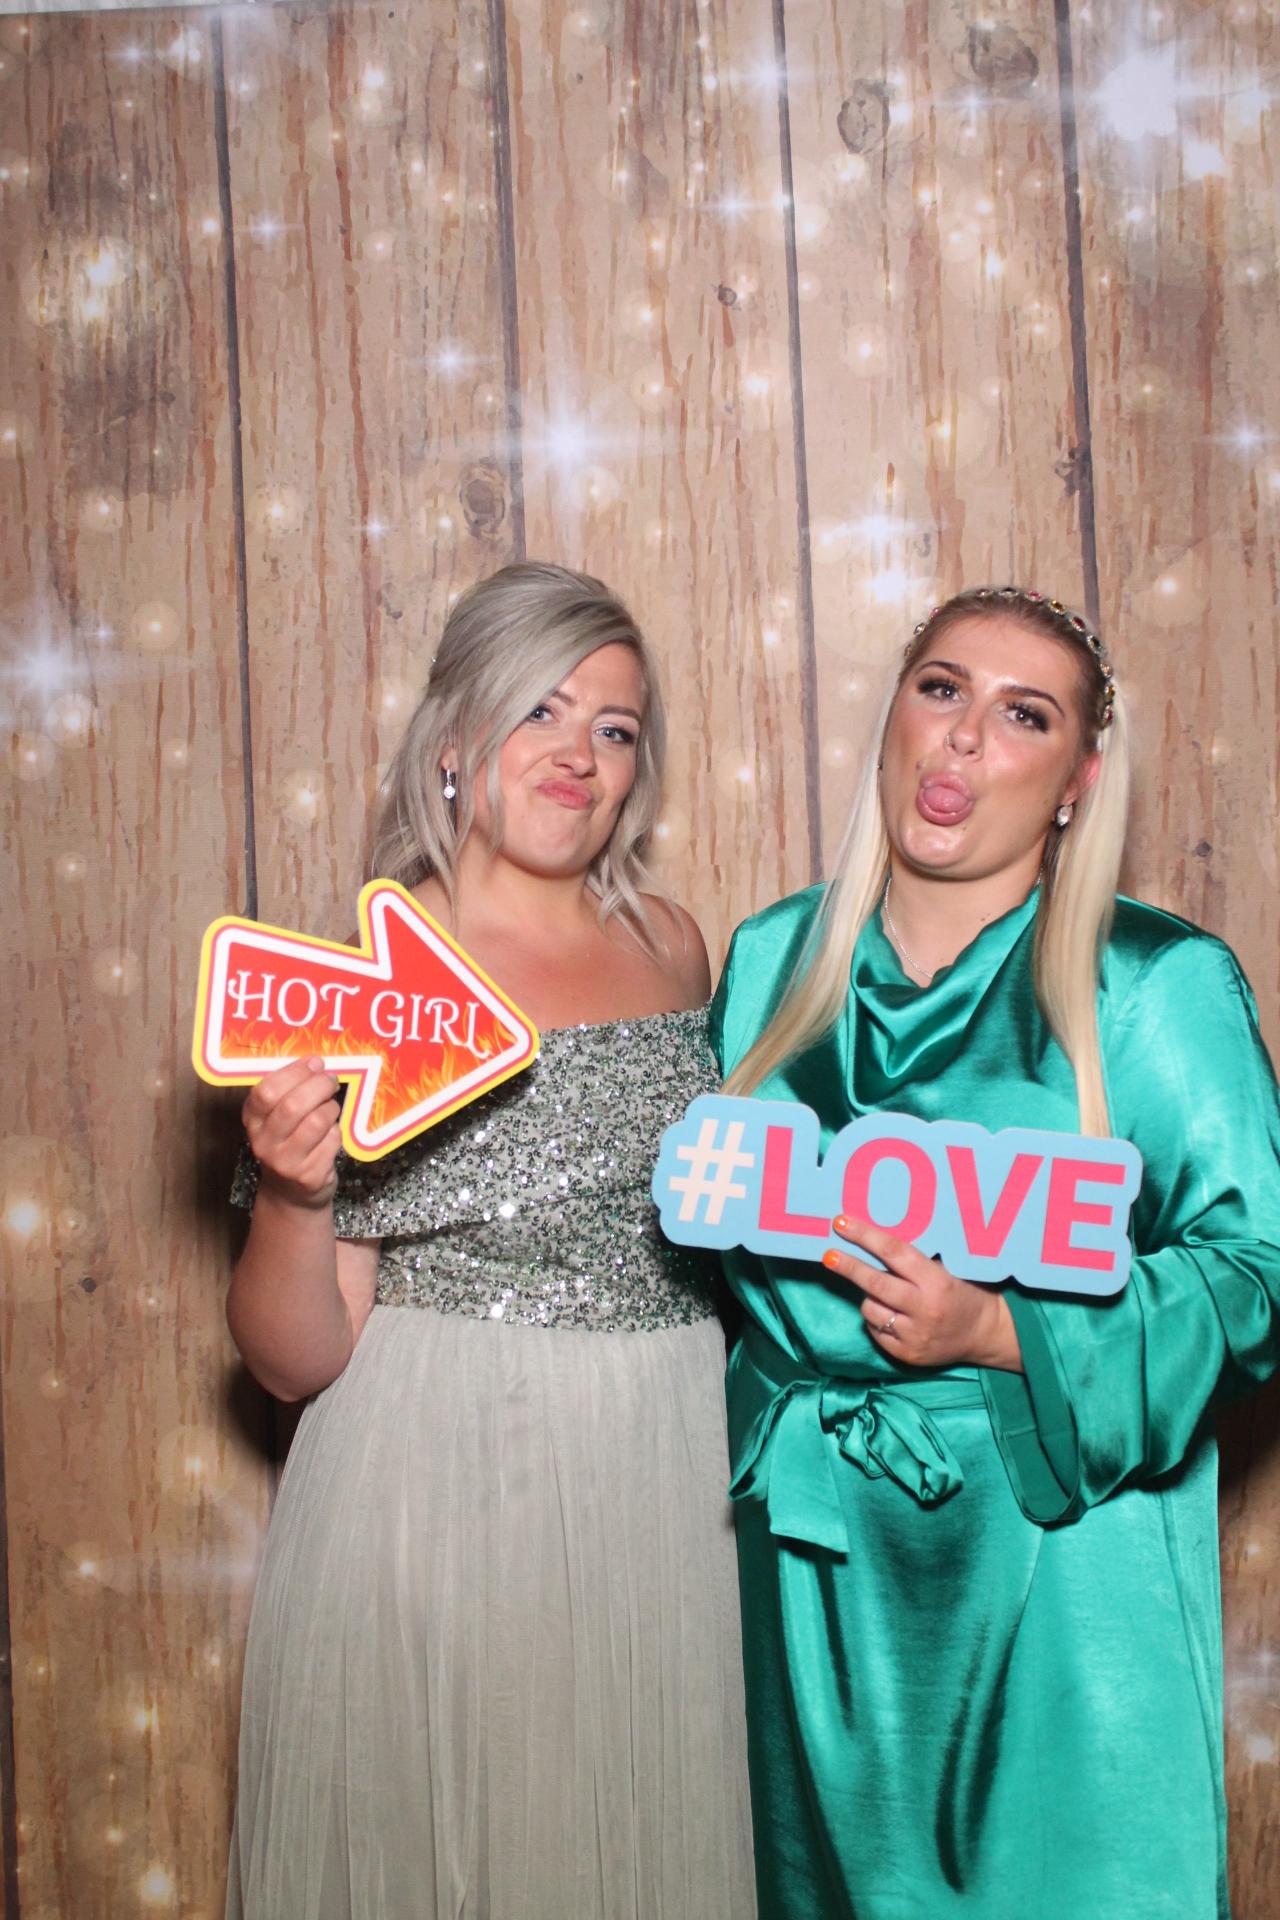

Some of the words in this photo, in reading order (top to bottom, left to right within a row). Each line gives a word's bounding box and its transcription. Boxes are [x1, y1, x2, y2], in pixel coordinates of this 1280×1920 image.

[228, 970, 360, 1031] HOT
[369, 991, 493, 1059] GIRL
[669, 1118, 1126, 1272] #LOVE
